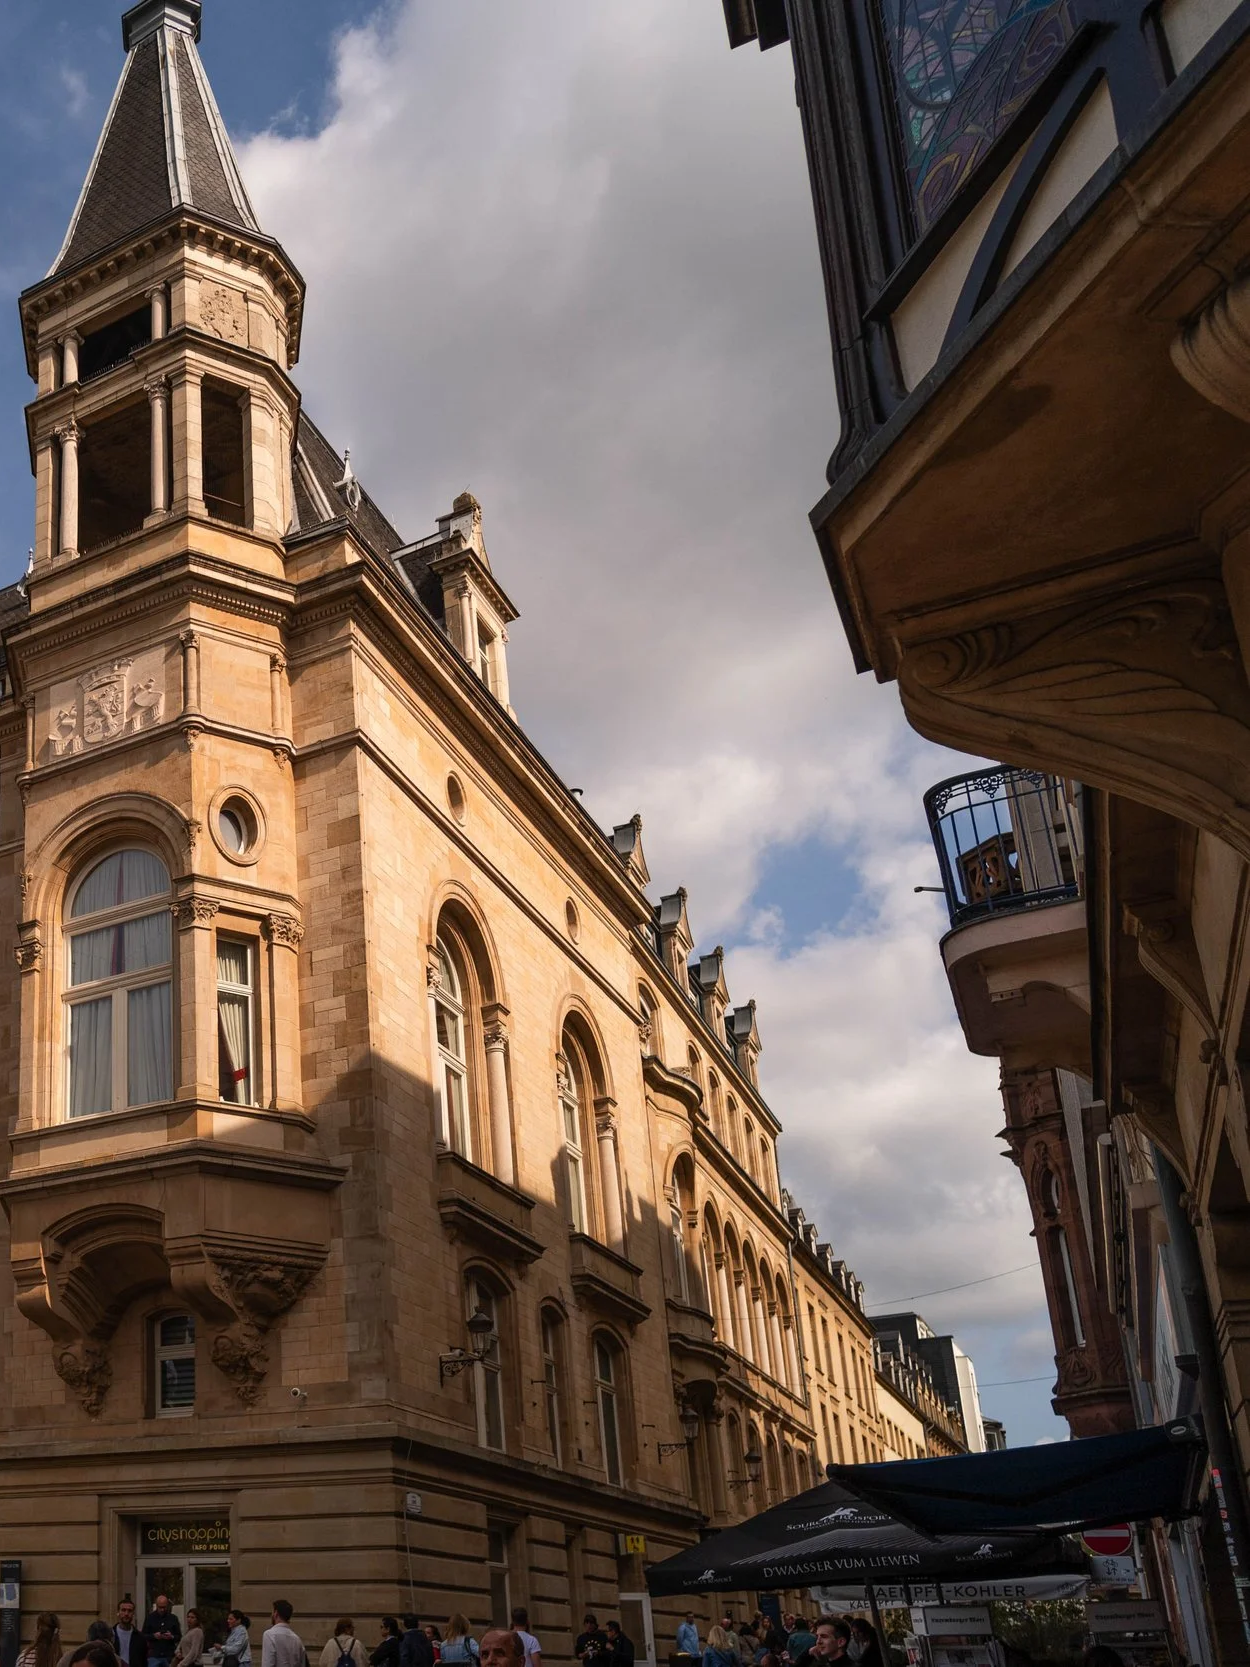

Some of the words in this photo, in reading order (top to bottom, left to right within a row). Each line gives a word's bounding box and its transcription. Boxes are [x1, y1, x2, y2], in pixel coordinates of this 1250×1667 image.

[147, 1521, 230, 1543] cityshoppin
[785, 1517, 835, 1531] SOURCES
[763, 1559, 833, 1578] D'WAASSER
[834, 1558, 866, 1569] VUM
[869, 1554, 921, 1567] LIEWEN
